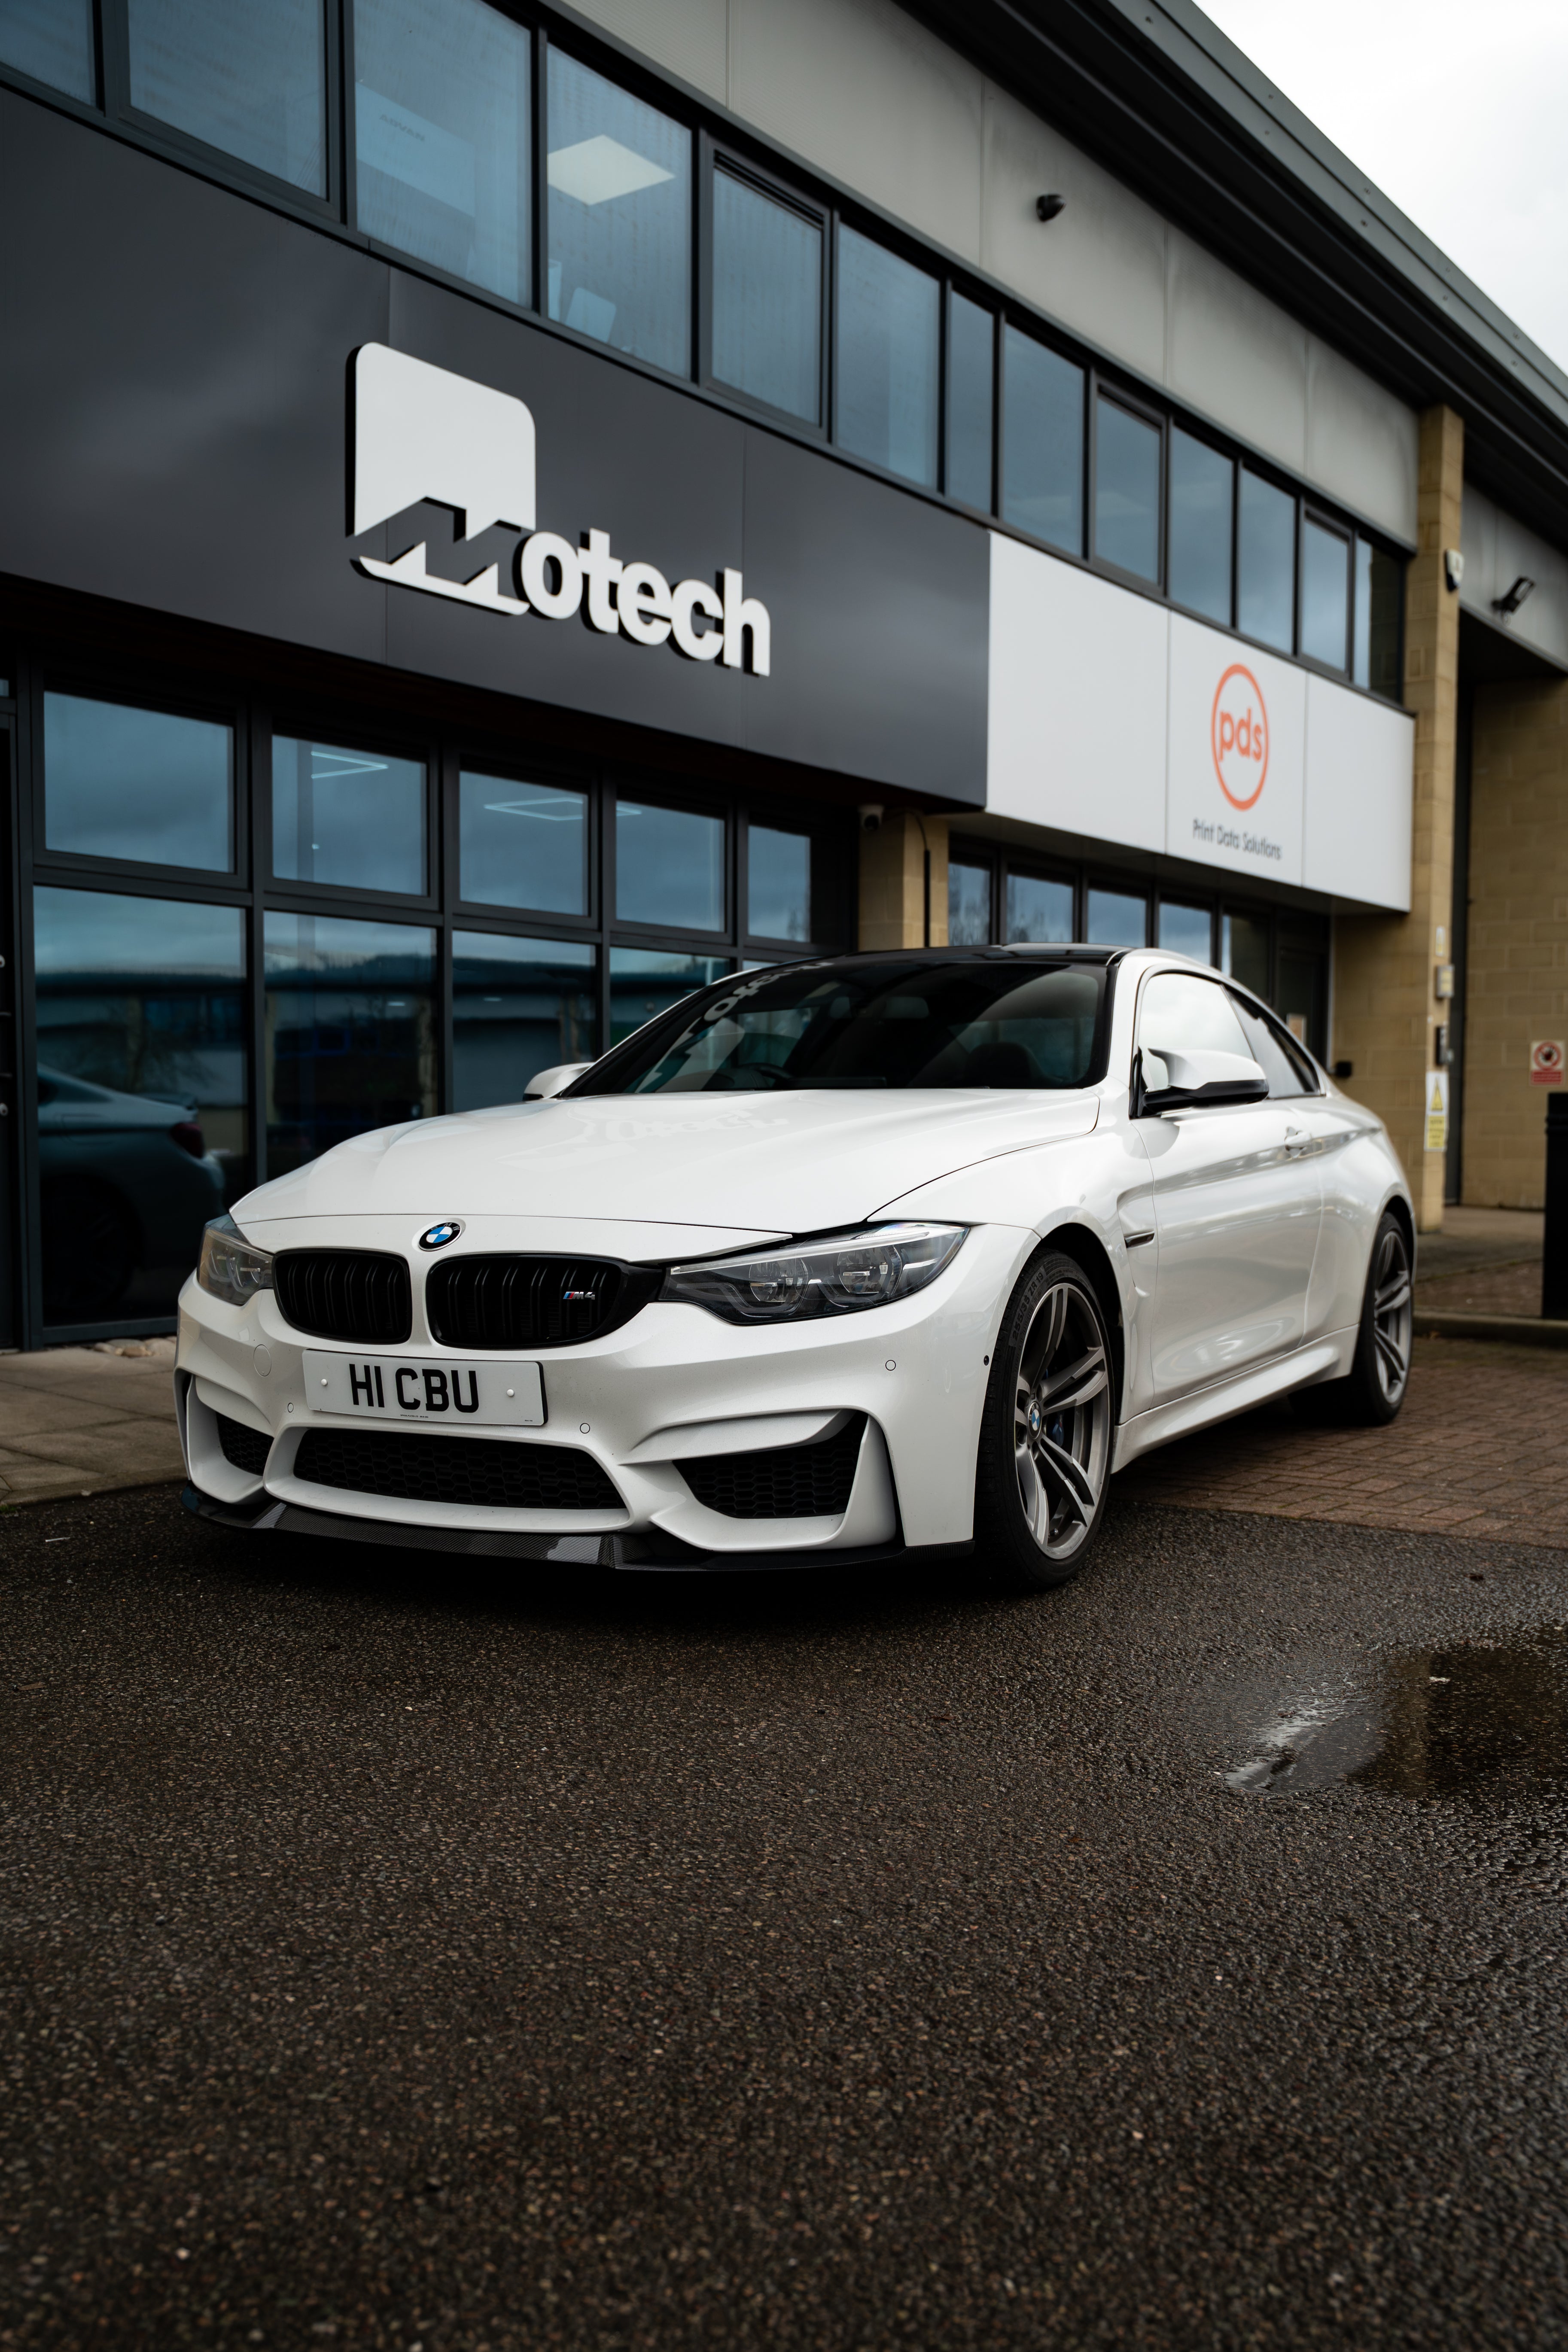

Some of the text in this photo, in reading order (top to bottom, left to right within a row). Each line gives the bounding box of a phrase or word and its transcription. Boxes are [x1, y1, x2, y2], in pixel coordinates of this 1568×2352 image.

[1219, 707, 1262, 762] pds
[1192, 817, 1282, 860] Print Data Solutions
[570, 1291, 596, 1300] M4
[1012, 1294, 1030, 1342] 255/35
[1027, 1281, 1038, 1296] ZR
[1036, 1272, 1044, 1283] 19
[395, 1367, 479, 1413] CBU
